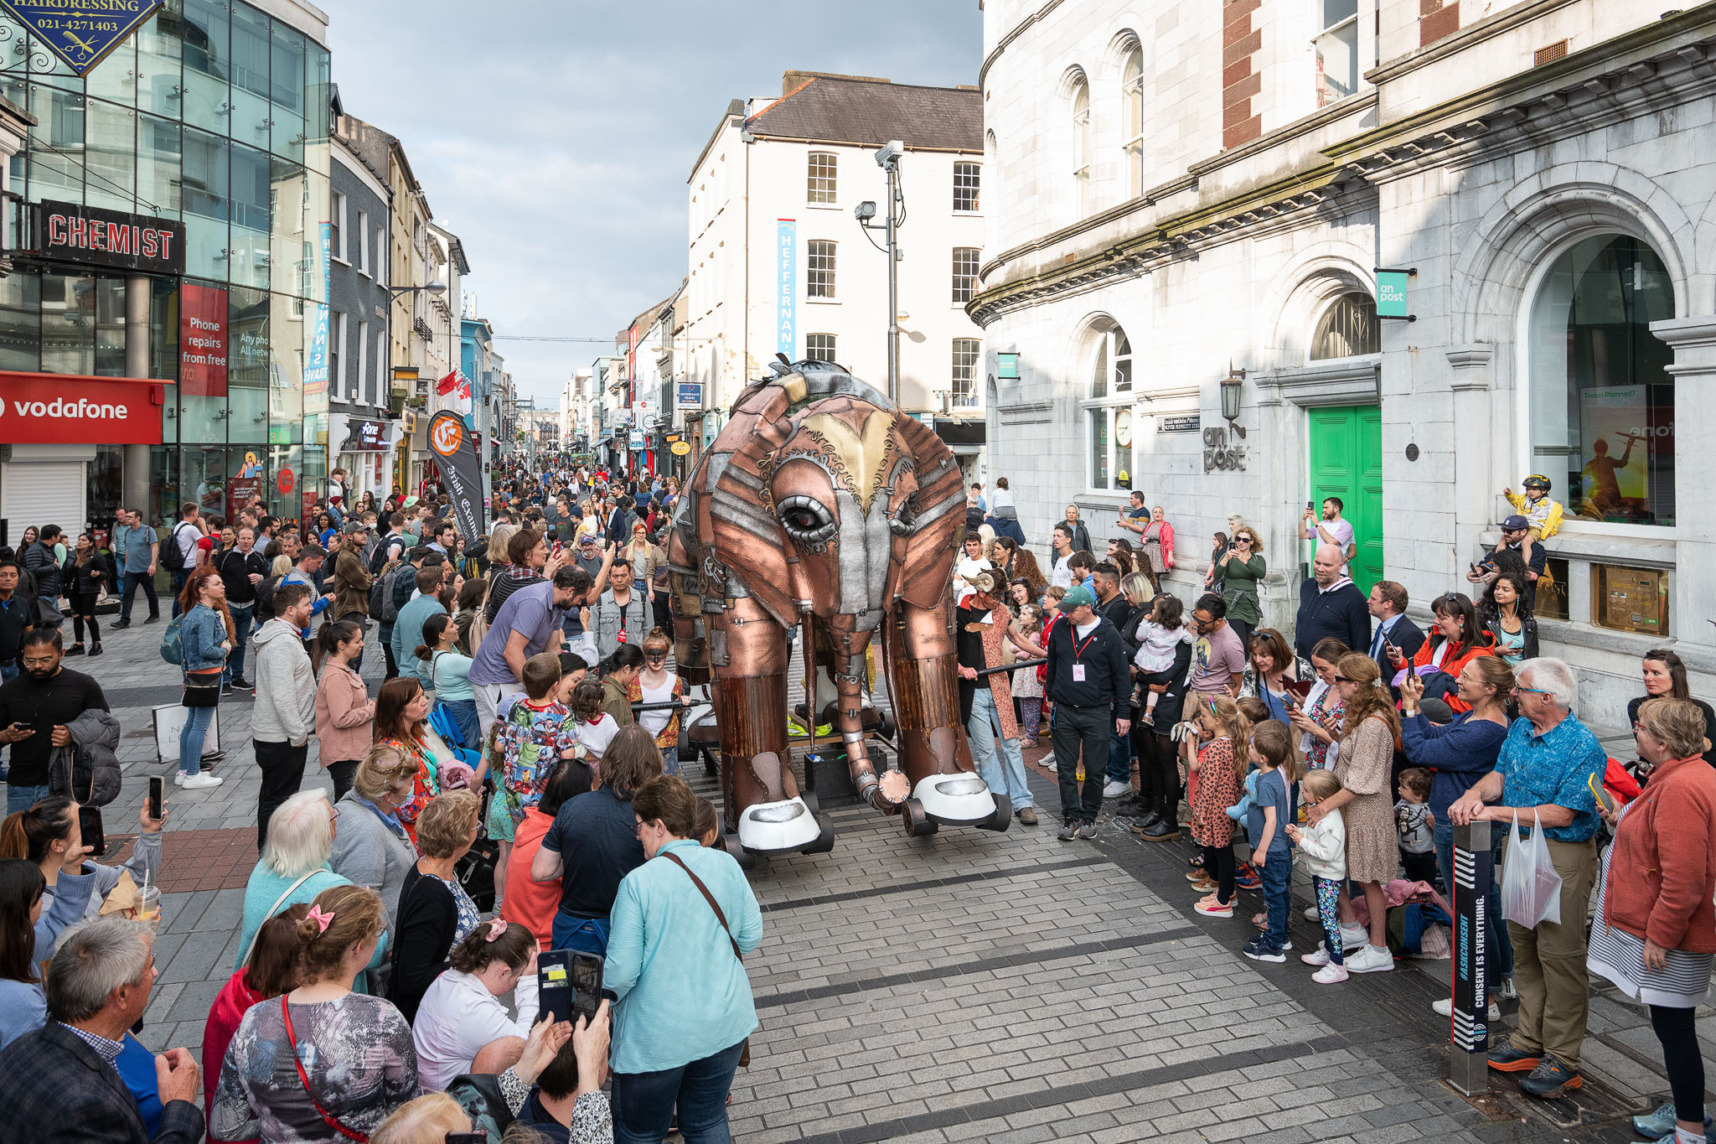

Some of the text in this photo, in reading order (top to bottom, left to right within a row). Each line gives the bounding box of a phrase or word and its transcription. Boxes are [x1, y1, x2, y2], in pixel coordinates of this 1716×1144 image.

[37, 18, 118, 32] 021-4271403
[48, 214, 173, 260] CHEMIST
[1380, 285, 1394, 293] an
[1380, 292, 1404, 303] post
[190, 317, 220, 331] Phone
[188, 337, 221, 349] repairs
[240, 333, 269, 347] Any pho
[240, 346, 251, 355] All
[183, 351, 226, 366] from free
[1605, 390, 1636, 398] Planned?
[13, 397, 128, 419] vodafone
[1203, 427, 1227, 447] an
[1203, 446, 1246, 474] post
[281, 475, 292, 486] 5G
[447, 465, 479, 542] Irish Examin
[1460, 913, 1469, 981] #ASKCONSENT
[1475, 895, 1485, 1008] CONSENT IS EVERYTHING.
